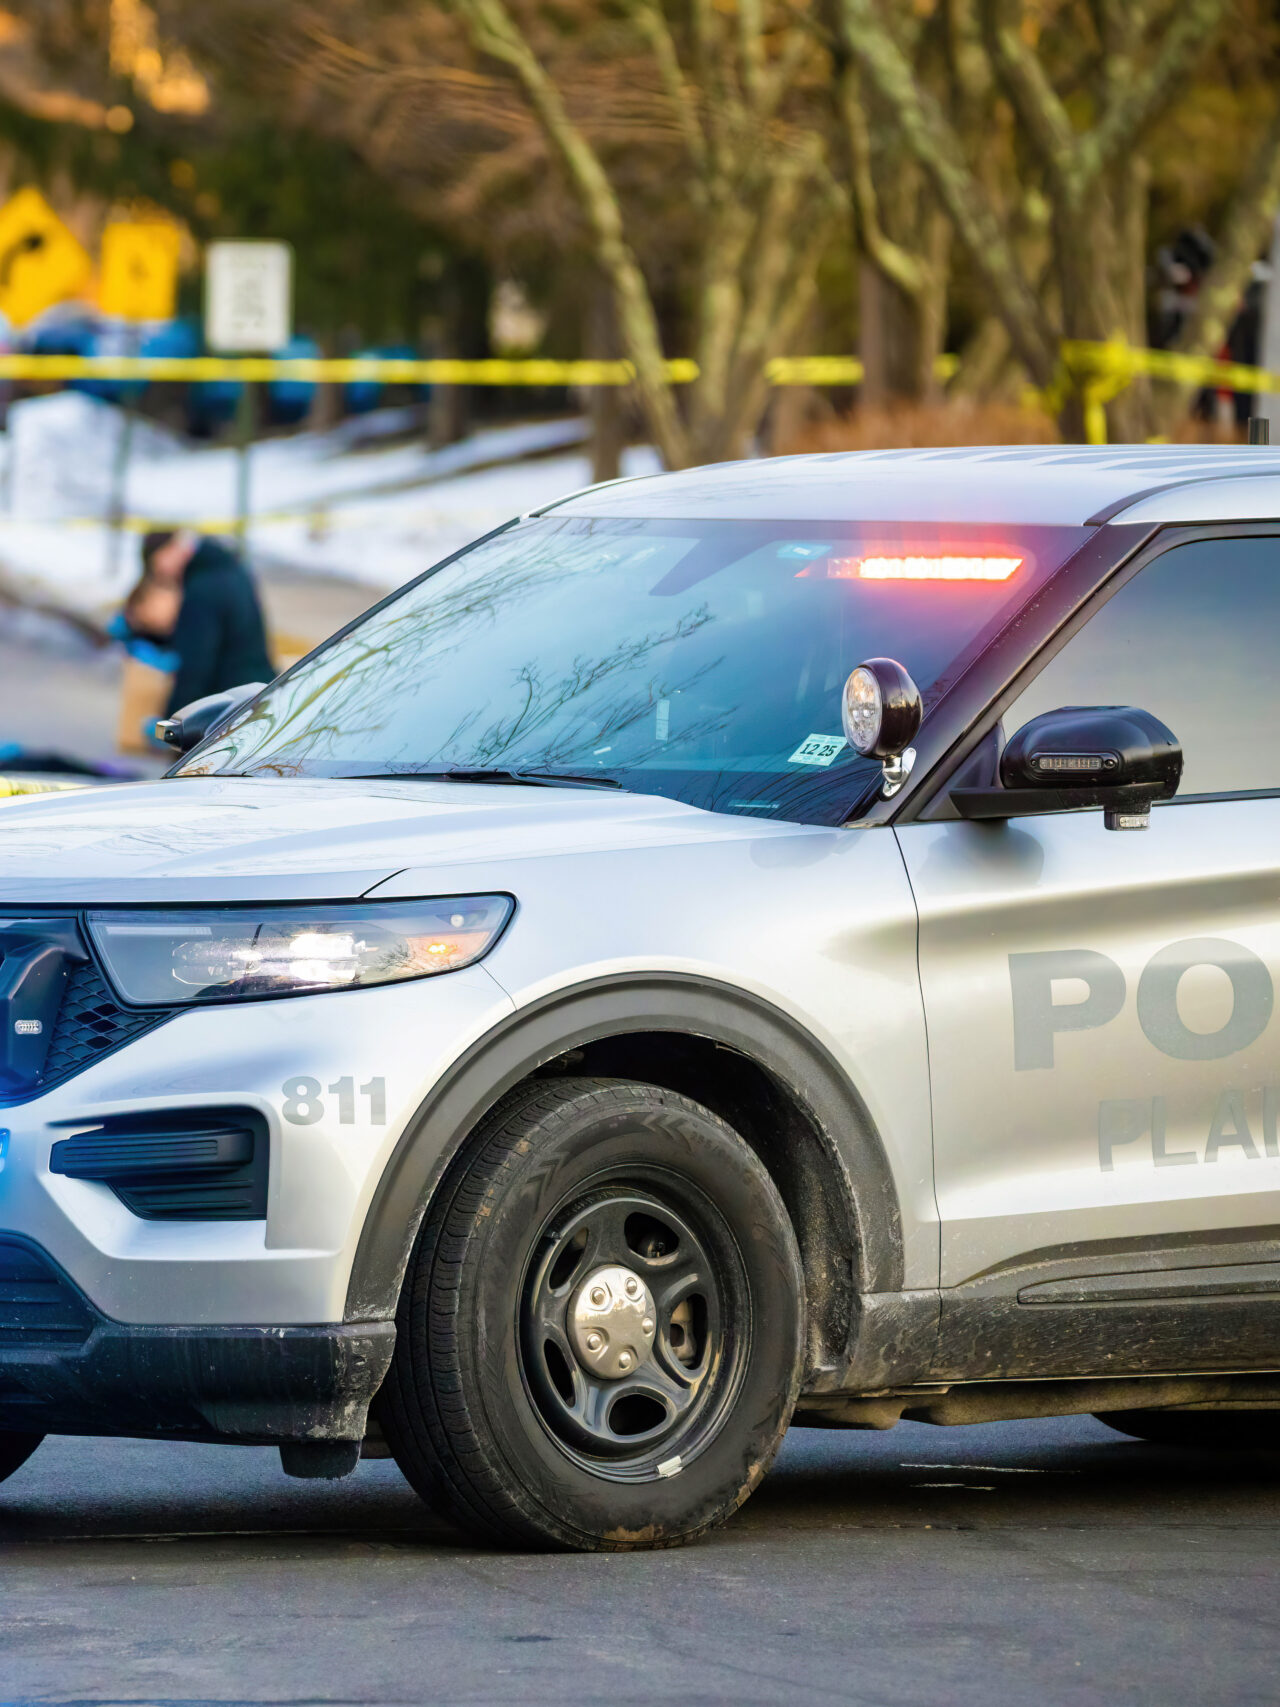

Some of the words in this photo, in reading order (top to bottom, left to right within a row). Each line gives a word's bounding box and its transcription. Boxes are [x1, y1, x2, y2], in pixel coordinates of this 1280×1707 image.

[800, 742, 821, 755] 12
[817, 744, 838, 756] 25
[1008, 937, 1274, 1072] PO
[281, 1075, 387, 1126] 811
